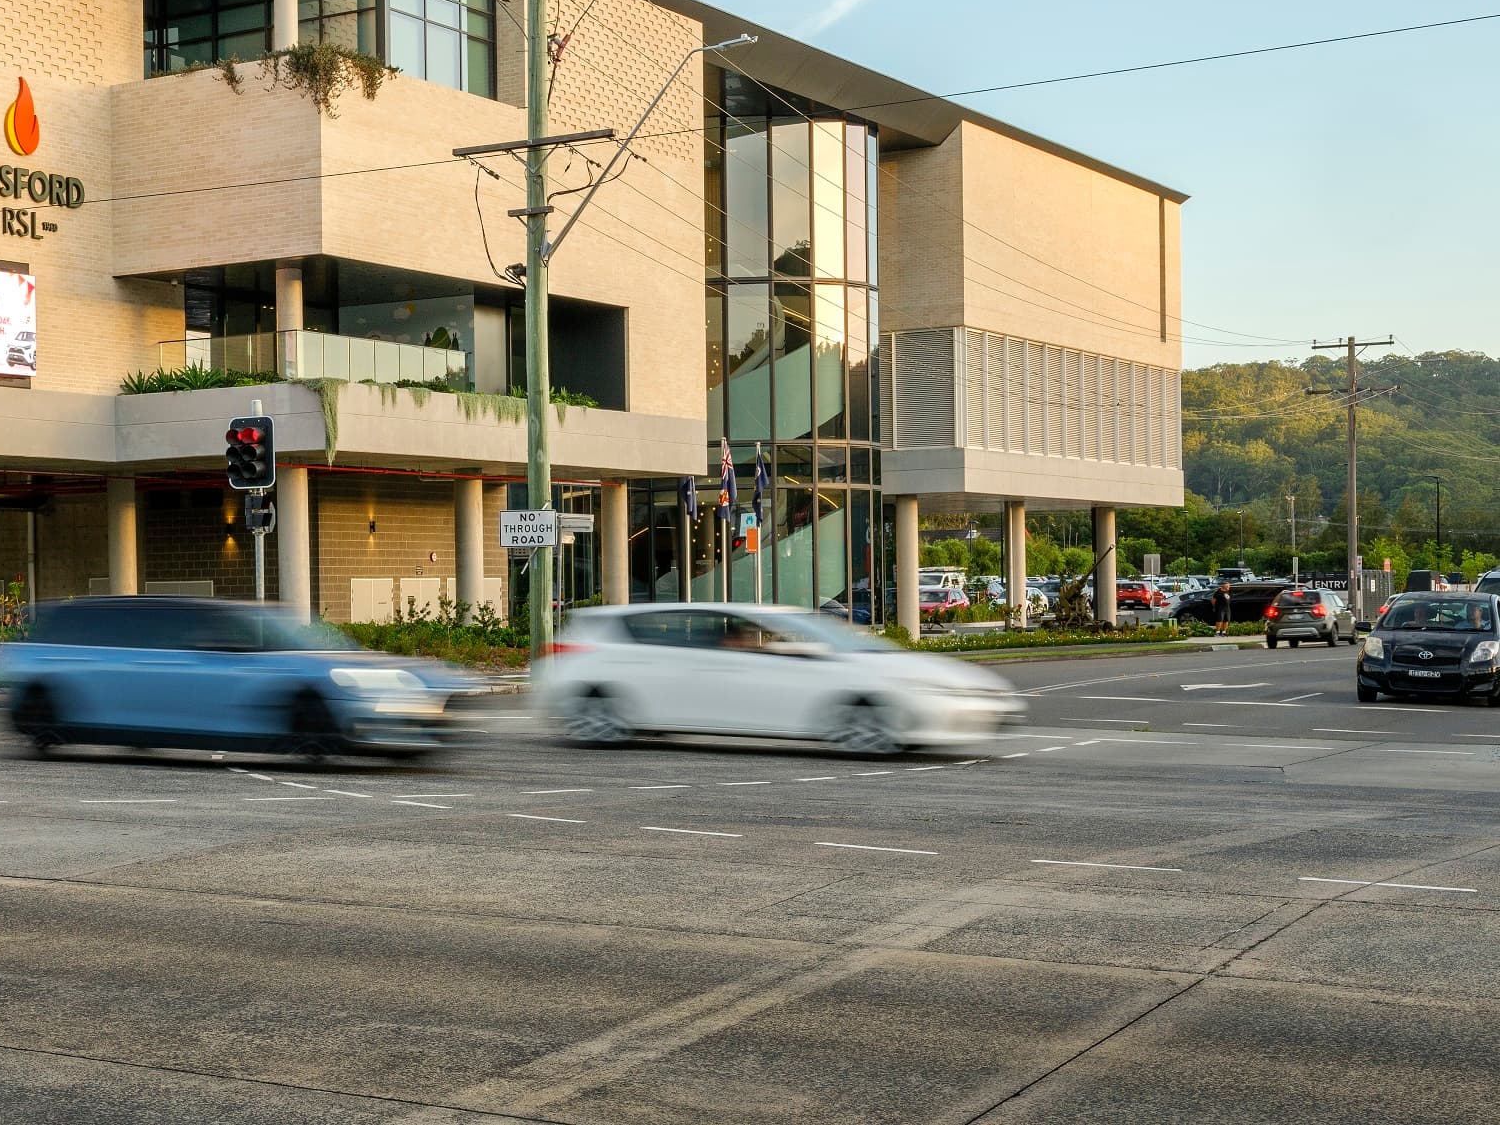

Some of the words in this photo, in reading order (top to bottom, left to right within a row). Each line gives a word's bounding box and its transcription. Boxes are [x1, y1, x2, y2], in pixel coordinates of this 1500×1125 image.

[2, 207, 44, 240] RSL
[519, 513, 536, 522] NO
[503, 523, 553, 533] THROUGH
[511, 536, 544, 544] ROAD
[1314, 580, 1348, 589] ENTRY
